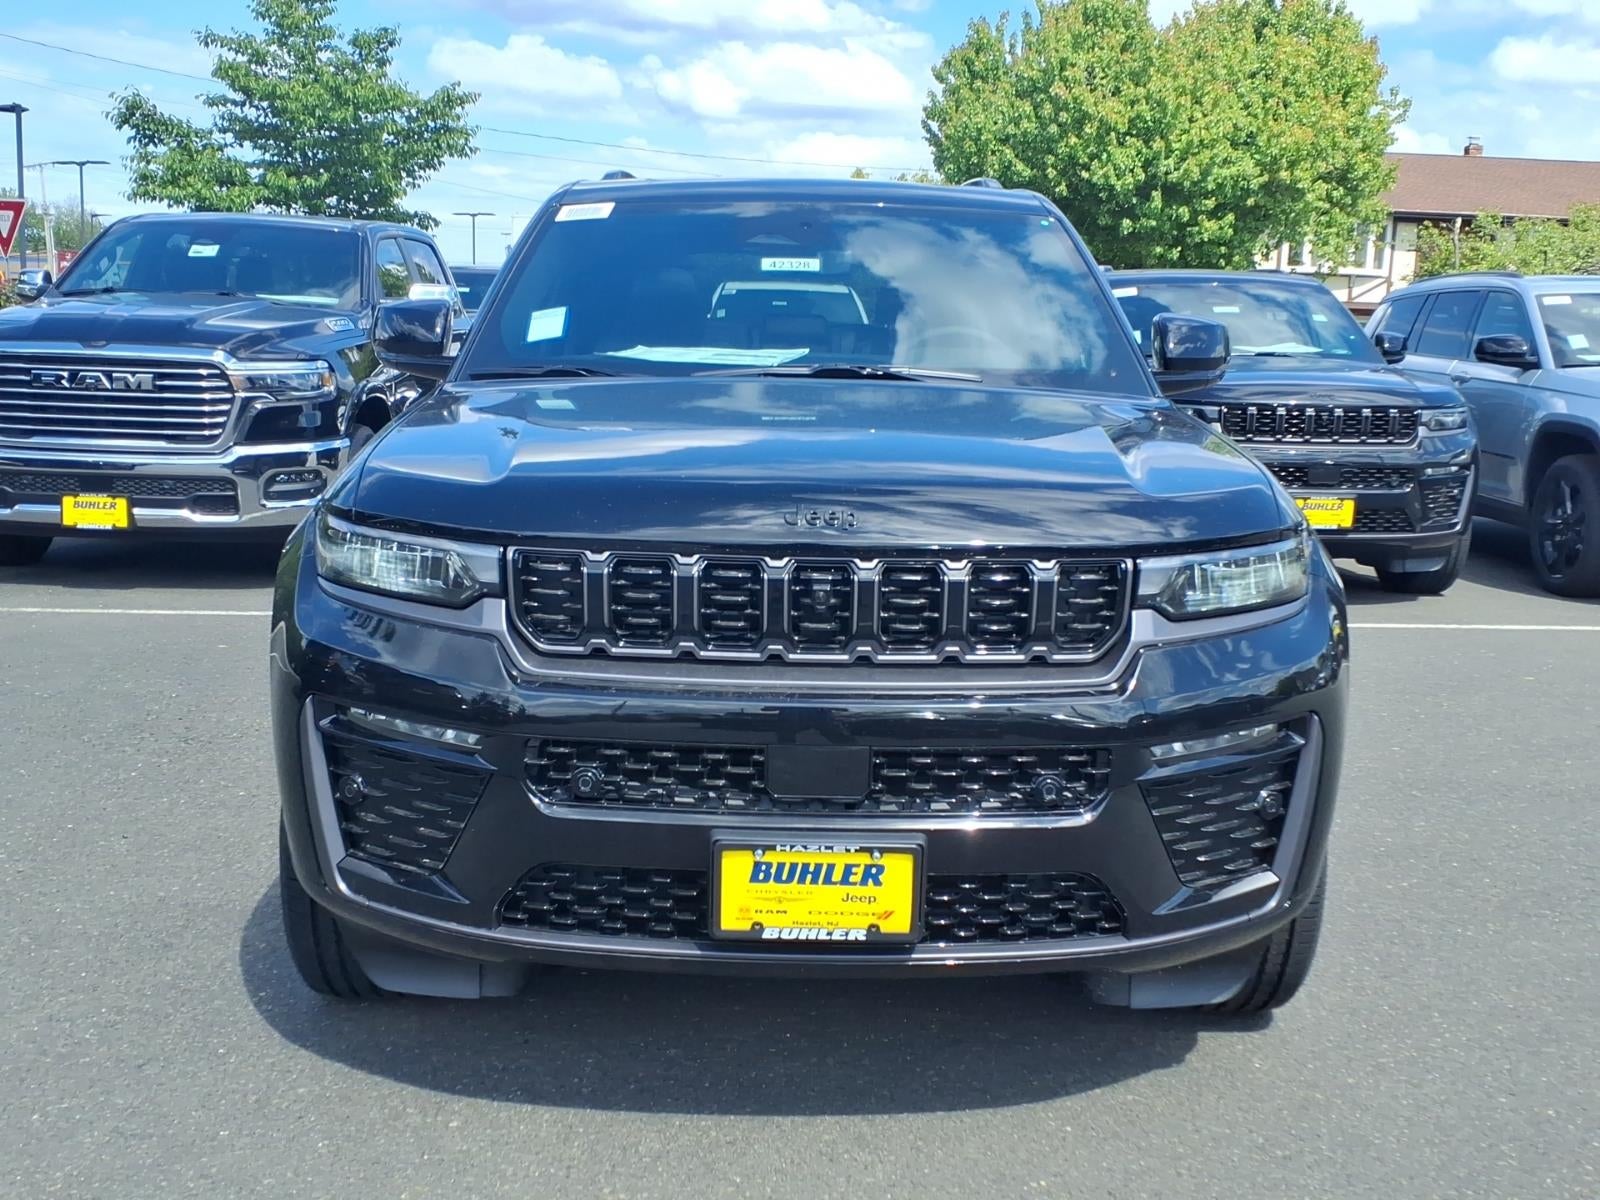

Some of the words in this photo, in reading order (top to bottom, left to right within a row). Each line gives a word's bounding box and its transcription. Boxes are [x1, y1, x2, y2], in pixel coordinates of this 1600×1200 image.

[31, 370, 154, 390] RAM
[73, 500, 117, 510] BUHLER
[1303, 502, 1344, 511] BUHLER
[783, 504, 857, 531] Jeep
[775, 844, 860, 853] HAZLET
[749, 861, 886, 887] BUHLER
[841, 892, 877, 904] Jeep
[762, 926, 867, 940] BUHLER
